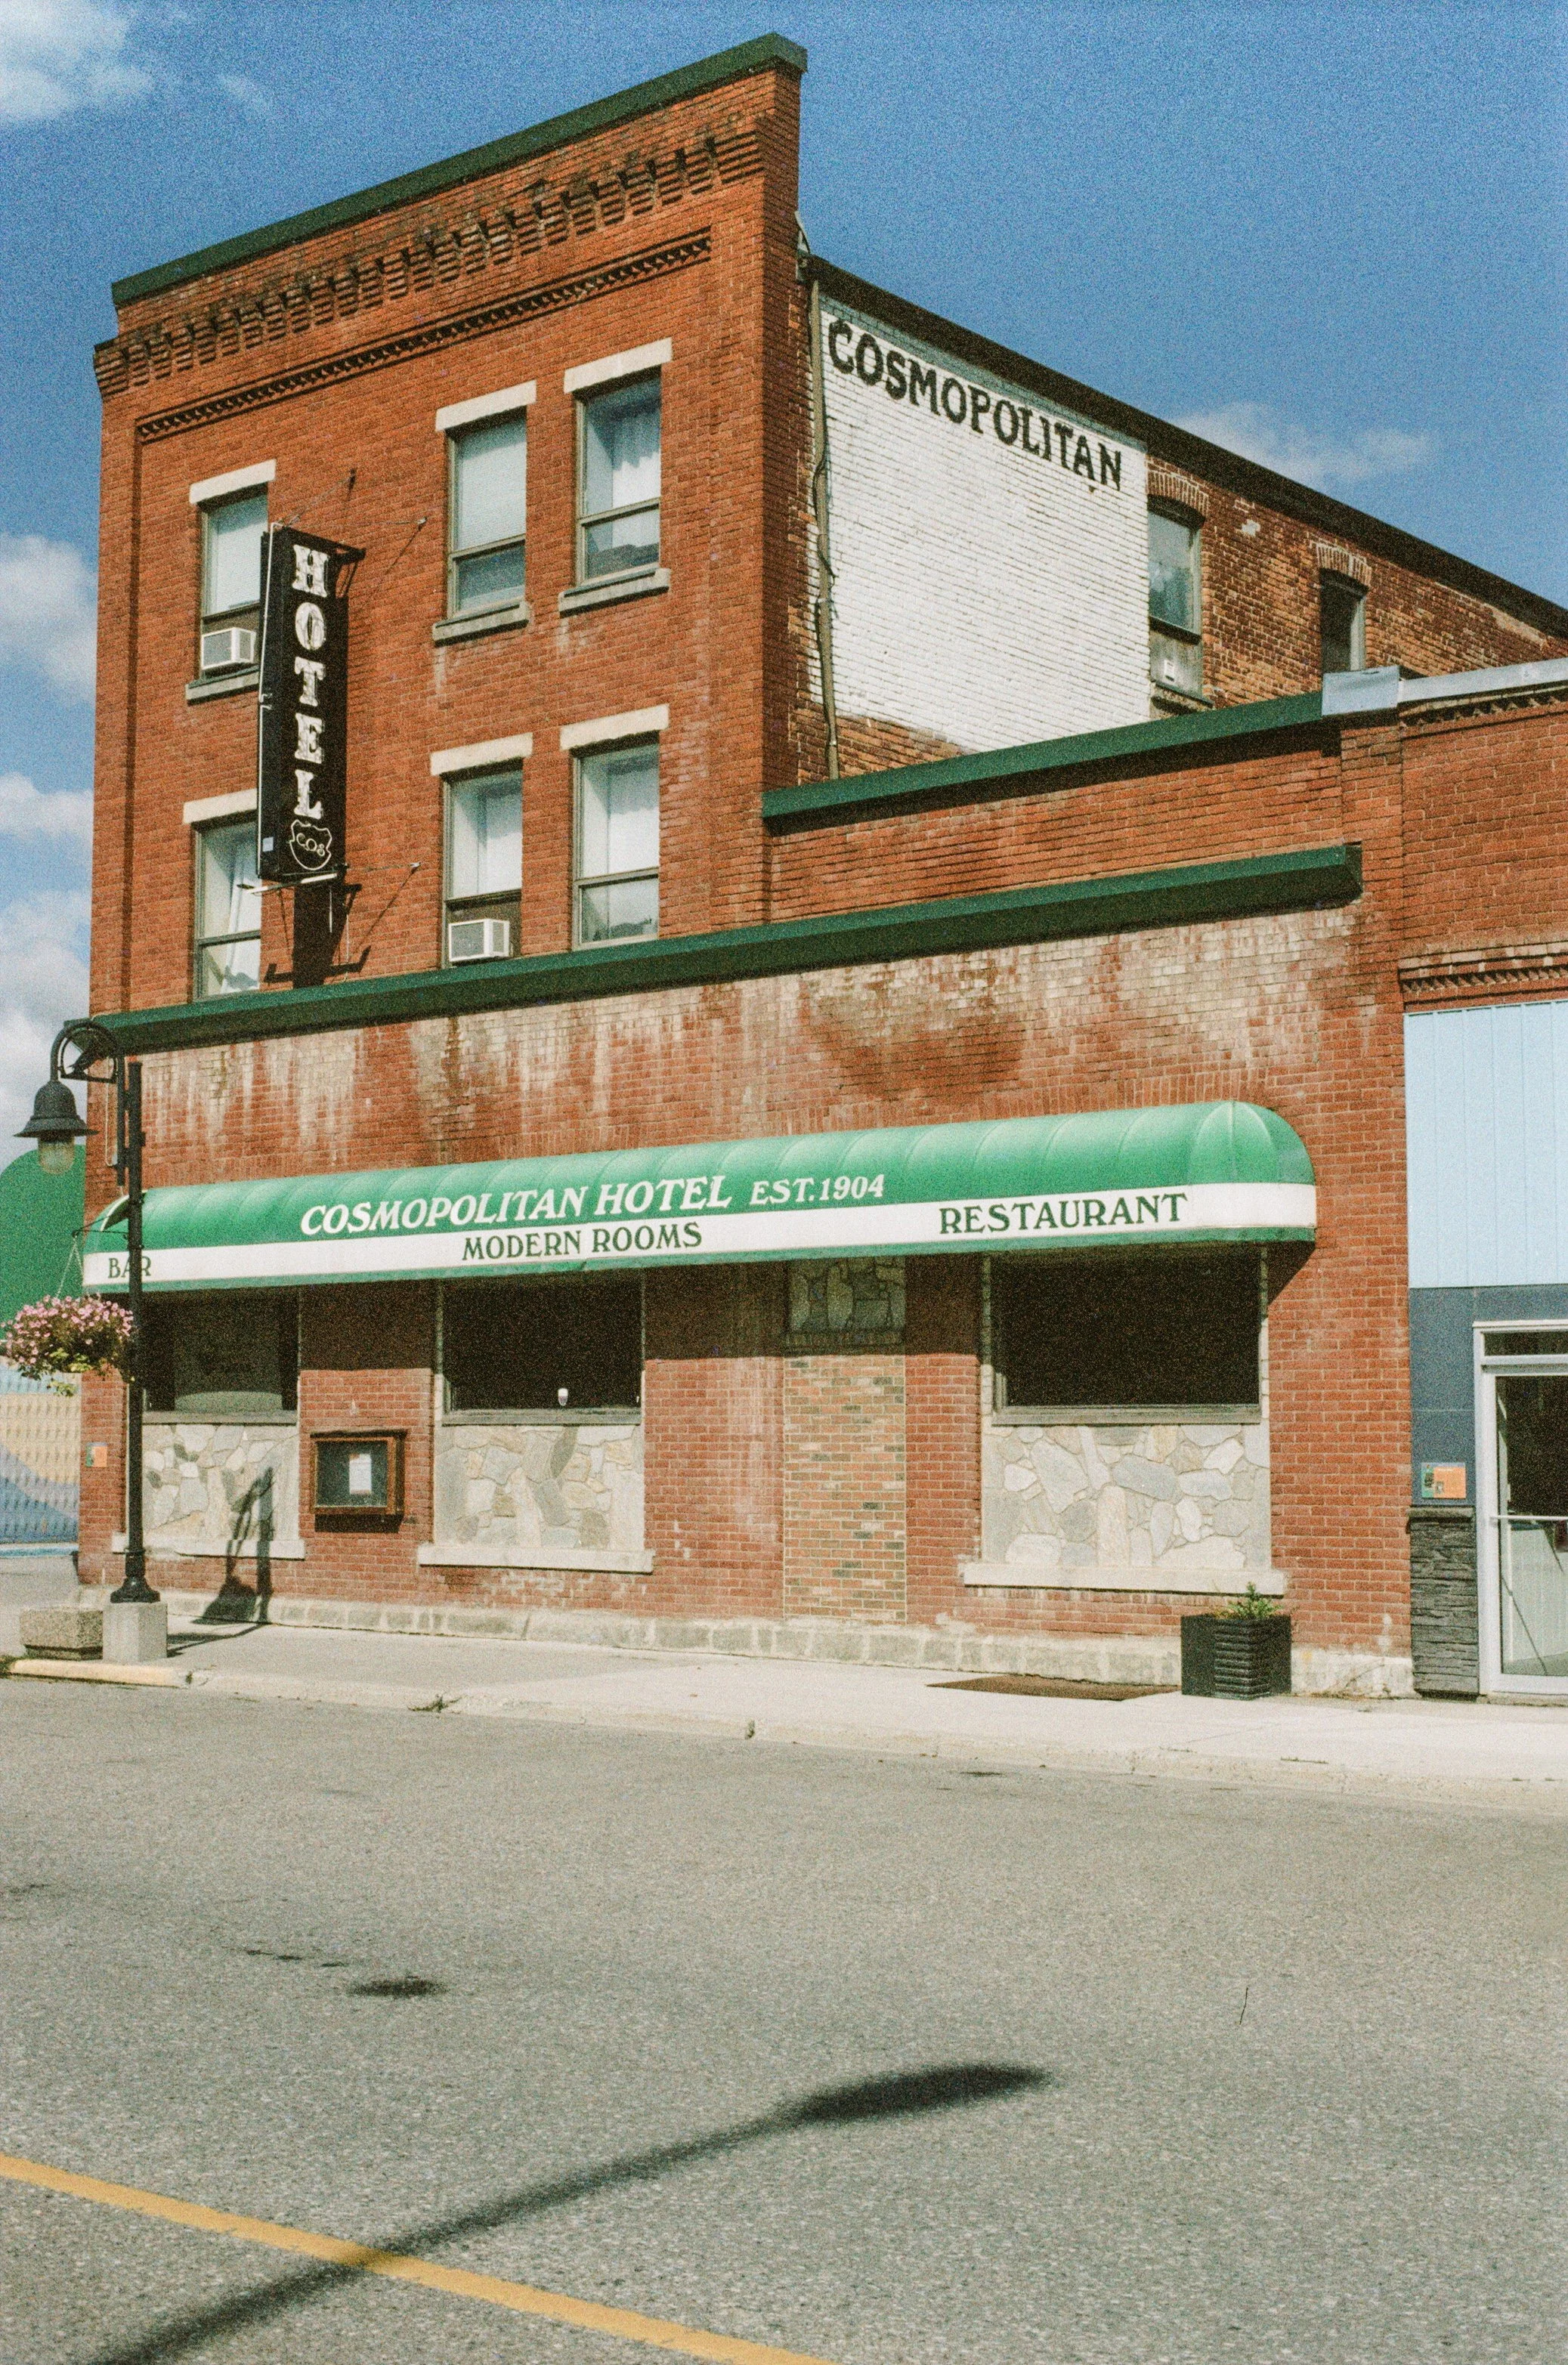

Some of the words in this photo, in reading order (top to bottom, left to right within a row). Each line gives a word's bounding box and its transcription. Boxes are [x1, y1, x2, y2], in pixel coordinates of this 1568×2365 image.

[828, 319, 1121, 491] COSMOPOLITAN
[292, 544, 329, 819] HOTEL
[301, 1187, 588, 1235] COSMOPOLITAN
[594, 1176, 731, 1215] HOTEL
[939, 1193, 1188, 1235] RESTAURANT
[462, 1231, 582, 1260] MODERN
[592, 1222, 703, 1253] ROOMS
